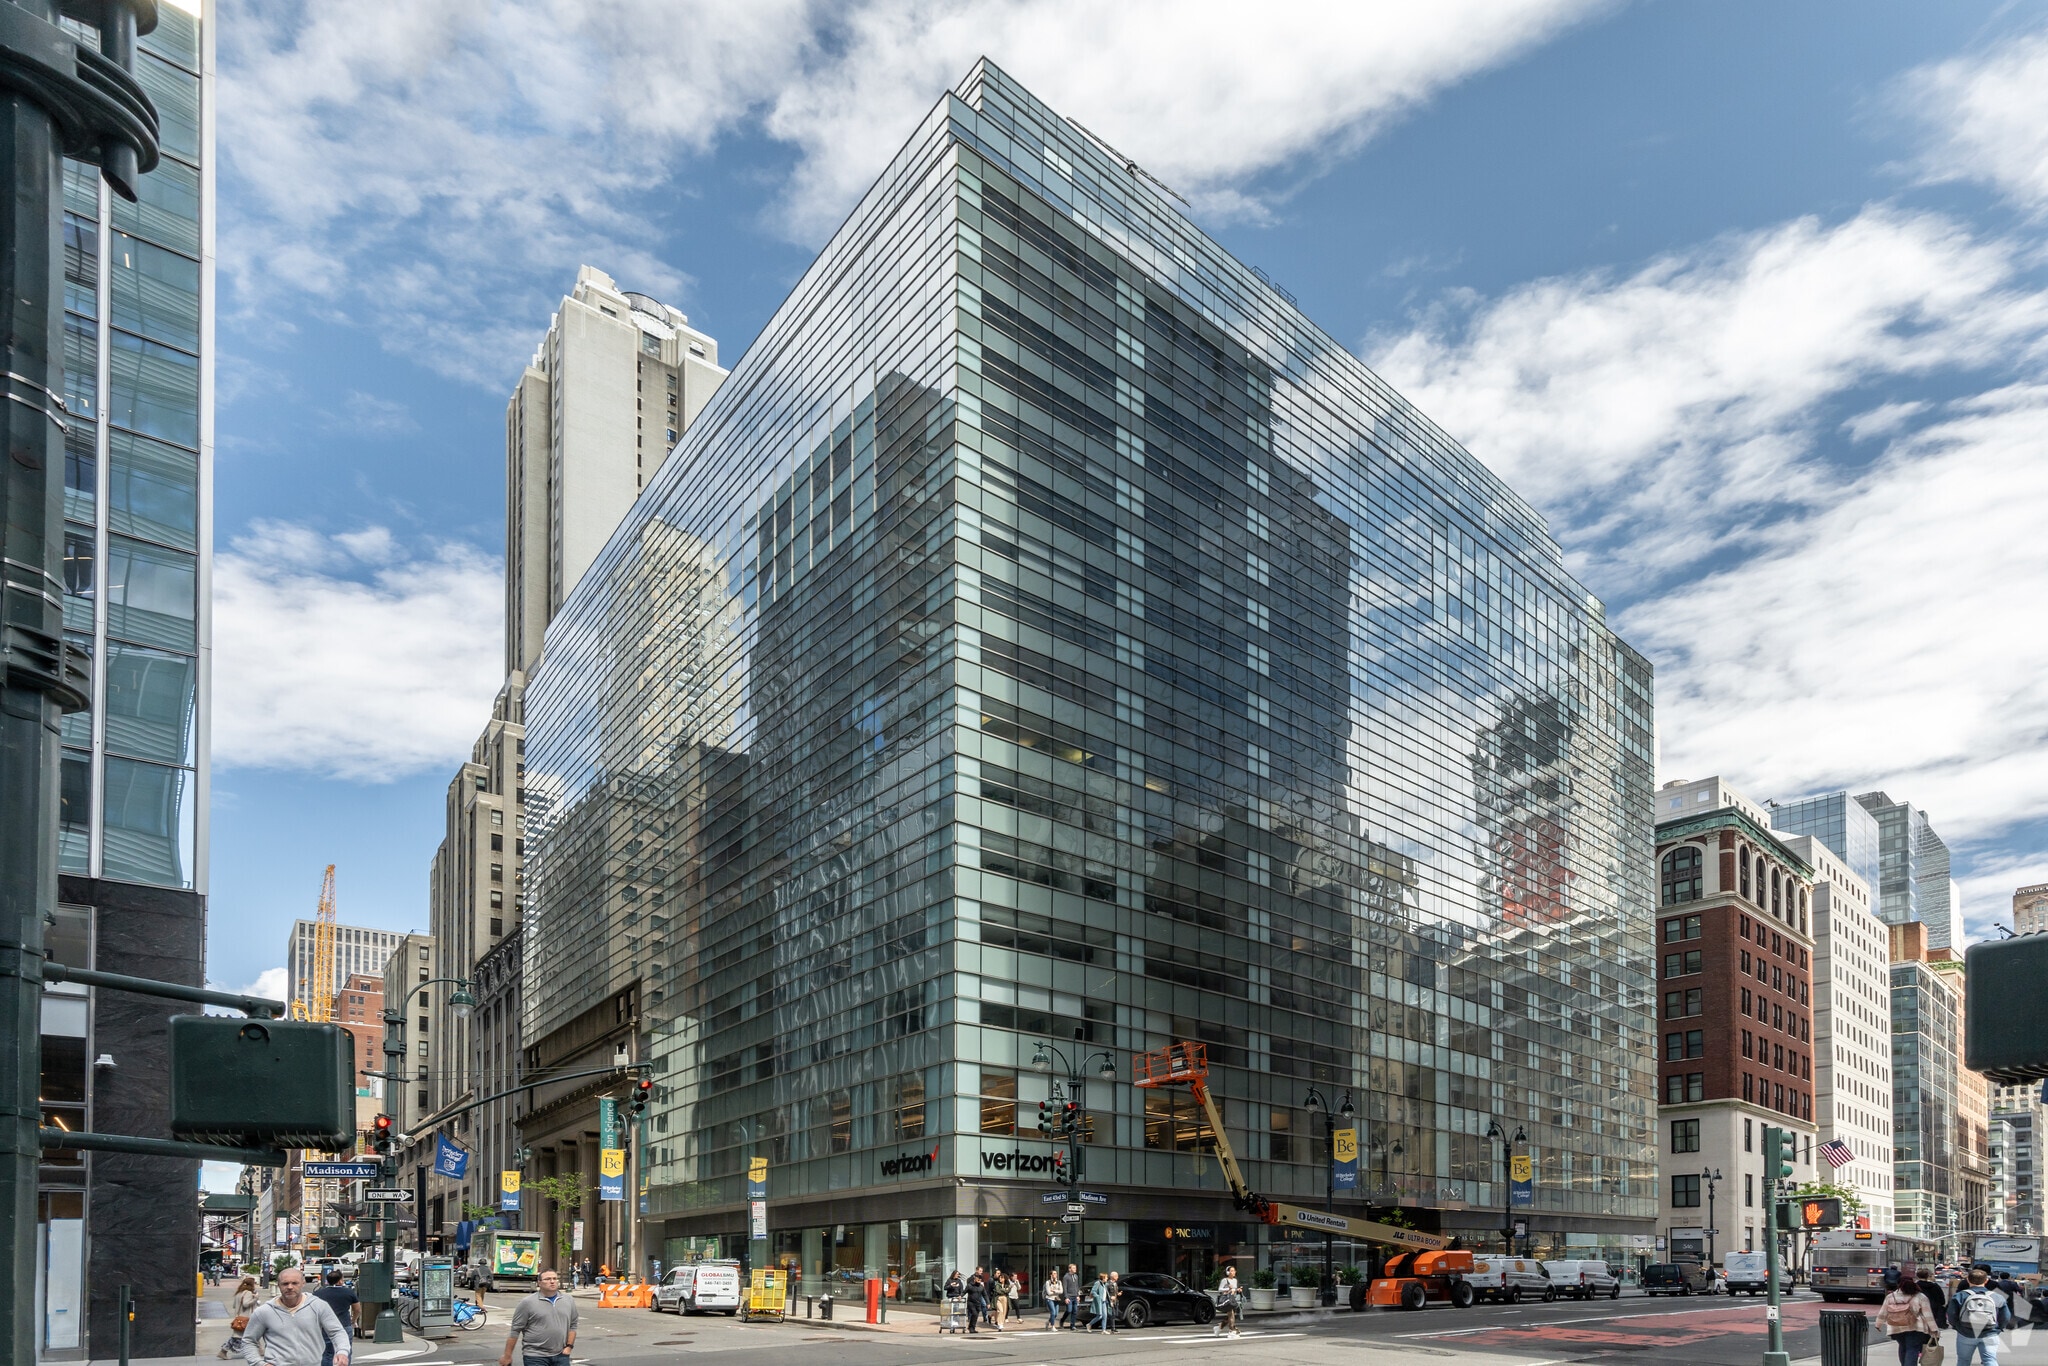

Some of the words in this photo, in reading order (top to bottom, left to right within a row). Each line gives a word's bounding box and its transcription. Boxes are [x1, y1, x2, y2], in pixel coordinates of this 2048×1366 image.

[604, 1102, 614, 1133] Science
[1336, 1138, 1355, 1153] Be
[604, 1156, 621, 1170] Be
[880, 1152, 932, 1176] verizon
[981, 1149, 1055, 1172] verizon
[307, 1166, 353, 1175] Madison
[355, 1166, 375, 1175] Ave
[1513, 1163, 1529, 1175] Be
[505, 1177, 517, 1187] Be
[1081, 1193, 1099, 1201] Madison
[1306, 1214, 1325, 1224] United
[1326, 1218, 1347, 1228] Rentals
[1175, 1228, 1191, 1238] PNC
[1290, 1230, 1304, 1239] PNC
[1393, 1231, 1406, 1240] JLG
[1407, 1234, 1425, 1244] ULTRA
[1425, 1237, 1441, 1247] BOOM
